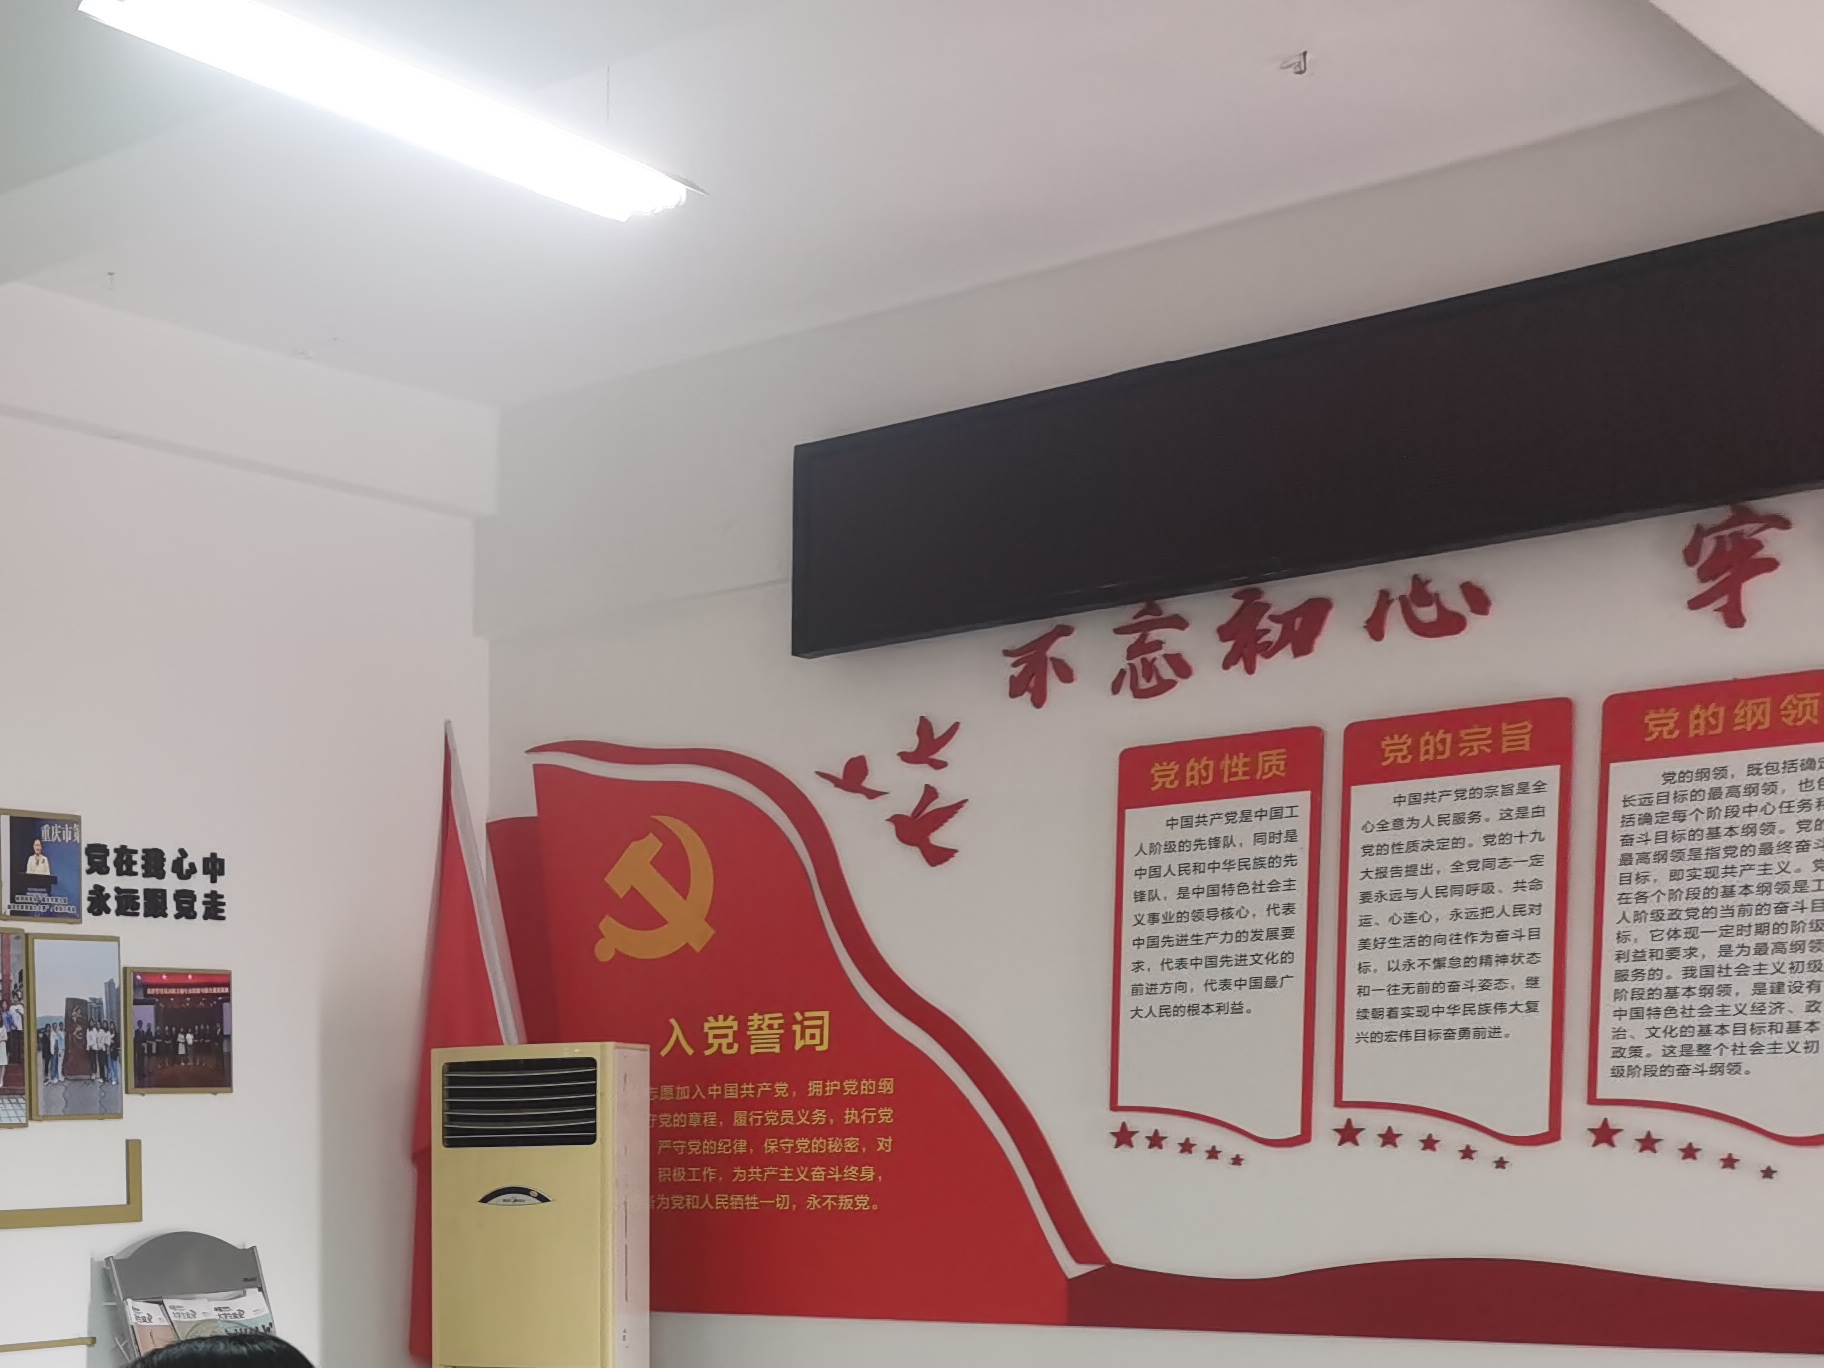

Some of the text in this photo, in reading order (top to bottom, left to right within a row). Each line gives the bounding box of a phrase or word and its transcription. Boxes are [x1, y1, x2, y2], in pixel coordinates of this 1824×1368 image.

[1002, 502, 1793, 709] 不忘初心 牢
[1644, 692, 1821, 742] 党的纲领
[1381, 721, 1532, 766] 党的宗旨
[1150, 748, 1287, 791] 党的性质
[1393, 780, 1547, 807] 中国共产党的宗旨是全
[1166, 805, 1299, 830] 中国共产党是中国工
[1361, 805, 1546, 834] 心全意为人民服务。这是由
[1135, 829, 1298, 857] 人阶级的先锋队，同时是
[1361, 830, 1545, 857] 党的性质决定的。党的十九
[84, 841, 226, 884] 党在我心中
[1134, 854, 1298, 880] 中国人民和中华民族的先
[1360, 855, 1544, 880] 大报告提出，全党同志一定
[86, 883, 227, 923] 永远跟党走
[1133, 878, 1297, 904] 锋队，是中国特色社会主
[1359, 879, 1543, 905] 要永远与人民同呼吸、共命
[1132, 903, 1296, 927] 义事业的领导核心，代表
[1358, 904, 1542, 927] 运、心连心，永远把人民对
[1616, 899, 1824, 925] 人阶级政党的当前的奋斗目
[1132, 927, 1296, 950] 中国先进生产力的发展要
[1358, 928, 1541, 951] 美好生活的向往作为奋斗目
[1131, 951, 1294, 973] 求，代表中国先进文化的
[1358, 952, 1541, 974] 标，以永不懈怠的精神状态
[1615, 939, 1824, 963] 利益和要求，是为最高纲领
[1614, 959, 1824, 983] 服务的。我国社会主义初级
[1131, 975, 1294, 997] 前进方向，代表中国最广
[1357, 976, 1540, 997] 和一往无前的奋斗姿态，继
[1613, 980, 1822, 1002] 阶段的基本纲领，是建设有
[1130, 1001, 1252, 1019] 大人民的根本利益。
[1356, 1001, 1539, 1021] 续朝着实现中华民族伟大复
[1613, 1000, 1822, 1021] 中国特色社会主义经济、政
[660, 1011, 830, 1057] 入党誓词
[1356, 1026, 1510, 1044] 兴的宏伟目标奋勇前进。
[1611, 1020, 1821, 1040] 治、文化的基本目标和基本
[1611, 1040, 1820, 1059] 政策。这是整个社会主义初
[1610, 1062, 1751, 1078] 级阶段的奋斗纲领。
[657, 1136, 893, 1156] 严守党的纪律，保守党的秘密，对
